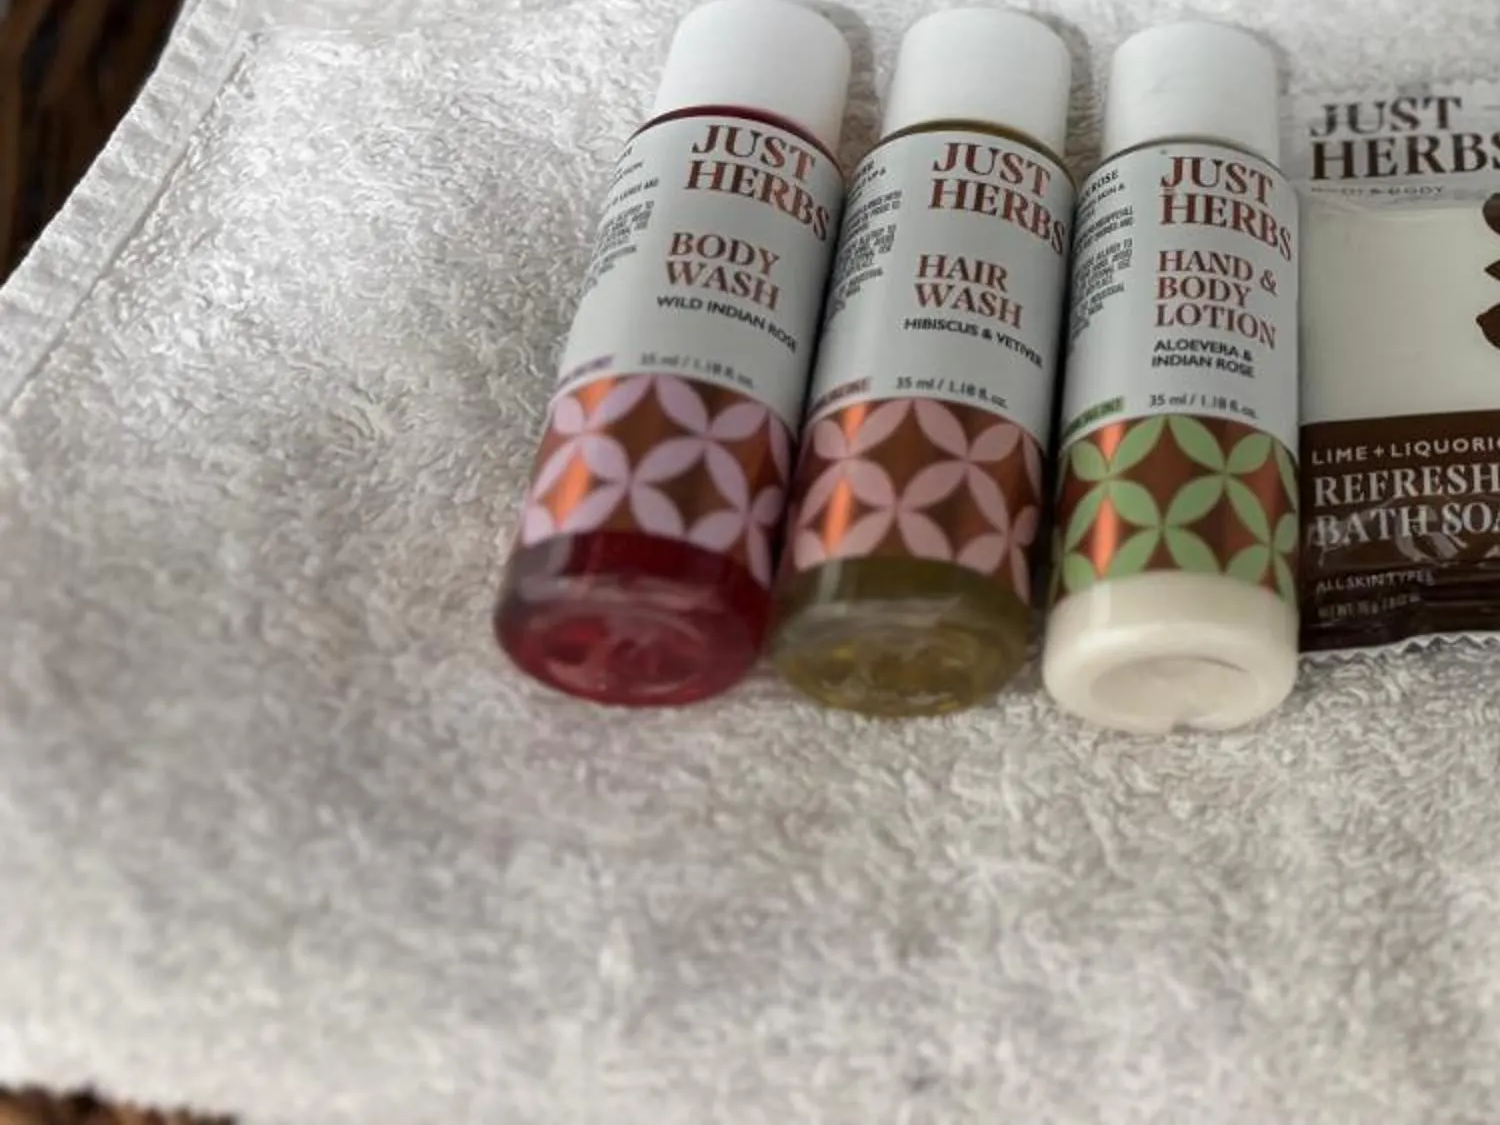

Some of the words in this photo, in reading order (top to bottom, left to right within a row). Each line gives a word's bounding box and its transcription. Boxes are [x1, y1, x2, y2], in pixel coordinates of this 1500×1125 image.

[1309, 95, 1462, 137] JUST
[692, 124, 816, 184] JUST
[932, 142, 1050, 198] JUST
[684, 160, 830, 242] HERBS
[1160, 156, 1273, 207] JUST
[928, 178, 1066, 256] HERBS
[1160, 193, 1292, 262] HERBS
[670, 231, 780, 276] BODY
[917, 254, 1008, 292] HAIR
[1157, 249, 1253, 282] HAND
[1260, 269, 1278, 296] &
[666, 261, 781, 311] WASH
[914, 283, 1024, 329] WASH
[1156, 276, 1250, 309] BODY
[657, 296, 702, 311] WILD
[707, 301, 766, 331] INDIAN
[1155, 303, 1277, 350] LOTION
[903, 318, 979, 336] HIBISCUS
[981, 328, 992, 340] &
[996, 332, 1043, 368] VETIVER
[1152, 354, 1213, 369] INDIAN
[1216, 357, 1256, 378] ROSE
[1154, 337, 1240, 360] ALOEVERA
[1244, 349, 1254, 361] &
[896, 376, 912, 389] 35
[916, 376, 934, 389] ml
[1150, 394, 1166, 407] 35
[1169, 394, 1186, 407] ml
[1315, 505, 1428, 547] BATH
